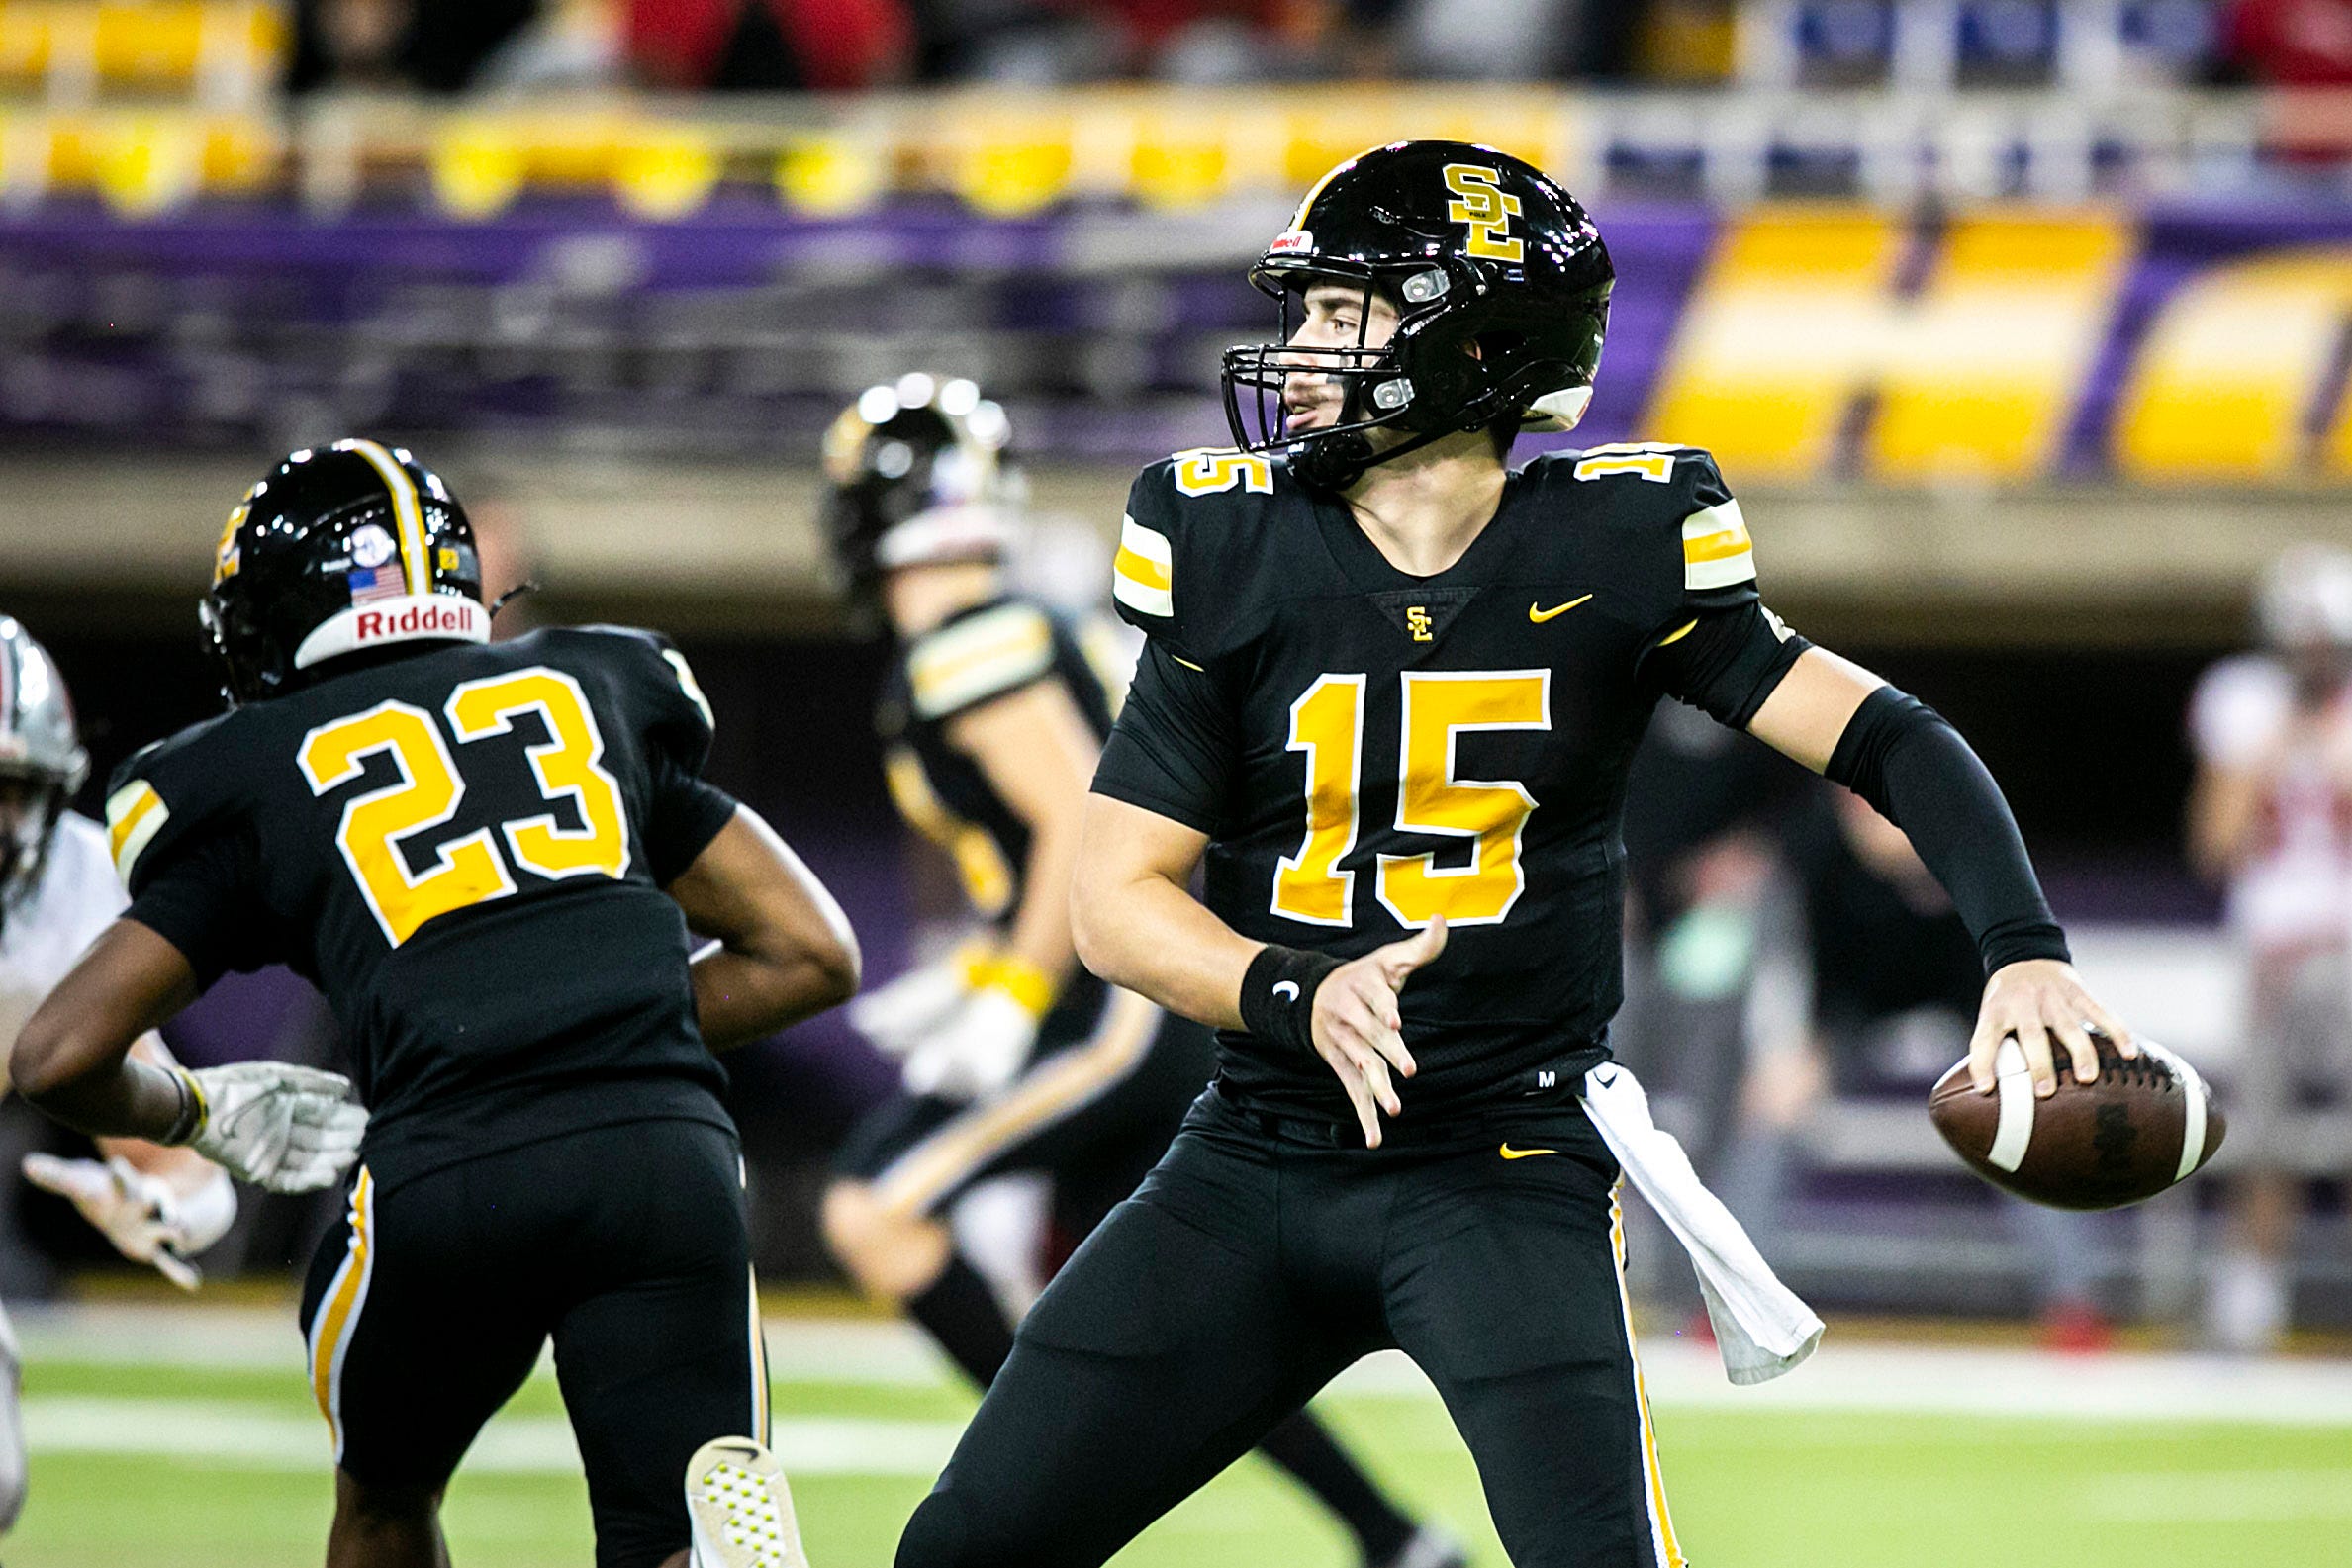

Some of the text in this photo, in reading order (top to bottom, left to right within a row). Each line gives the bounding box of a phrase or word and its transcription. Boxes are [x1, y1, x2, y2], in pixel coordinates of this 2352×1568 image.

[1172, 447, 1274, 498] 5
[357, 604, 472, 641] Riddell
[296, 666, 632, 949] 23
[1270, 668, 1552, 930] 15
[1539, 1071, 1556, 1088] M
